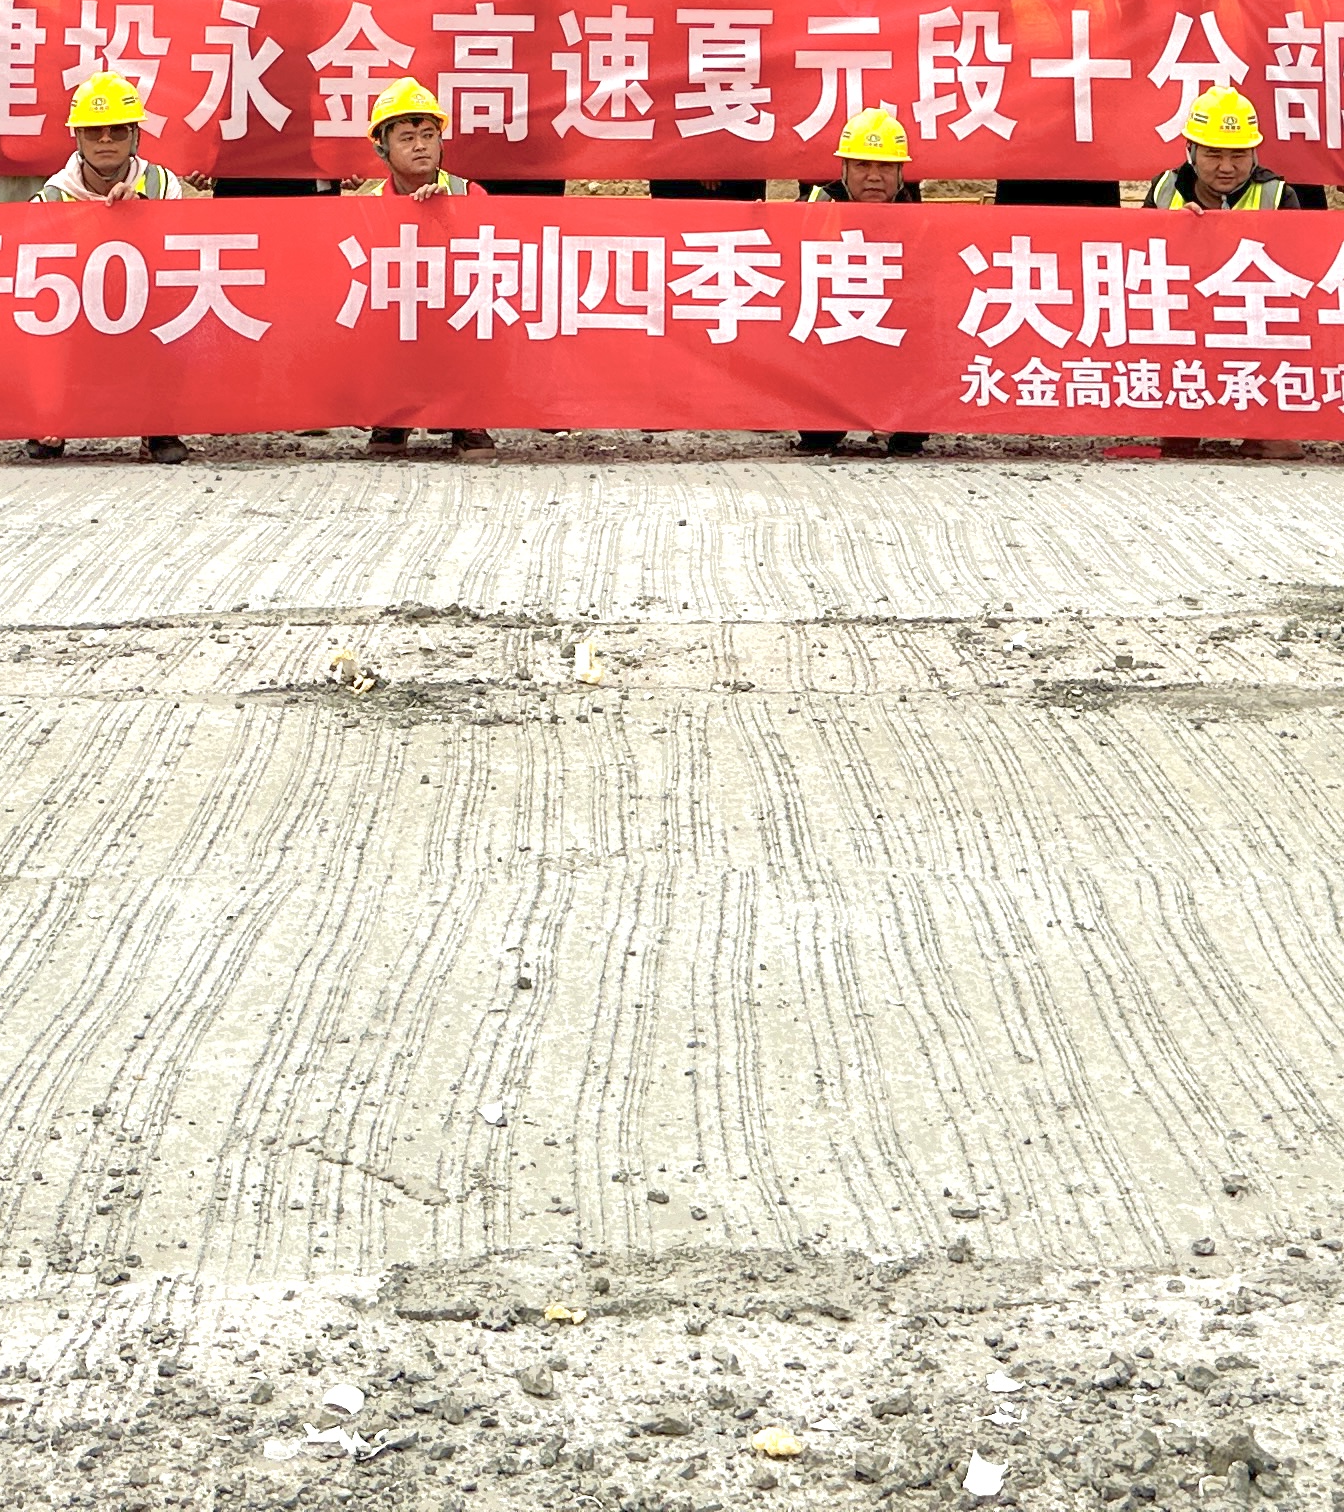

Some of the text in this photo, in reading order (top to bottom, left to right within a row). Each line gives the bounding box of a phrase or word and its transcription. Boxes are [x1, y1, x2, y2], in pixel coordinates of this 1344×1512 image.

[335, 224, 907, 347] 冲刺四季度
